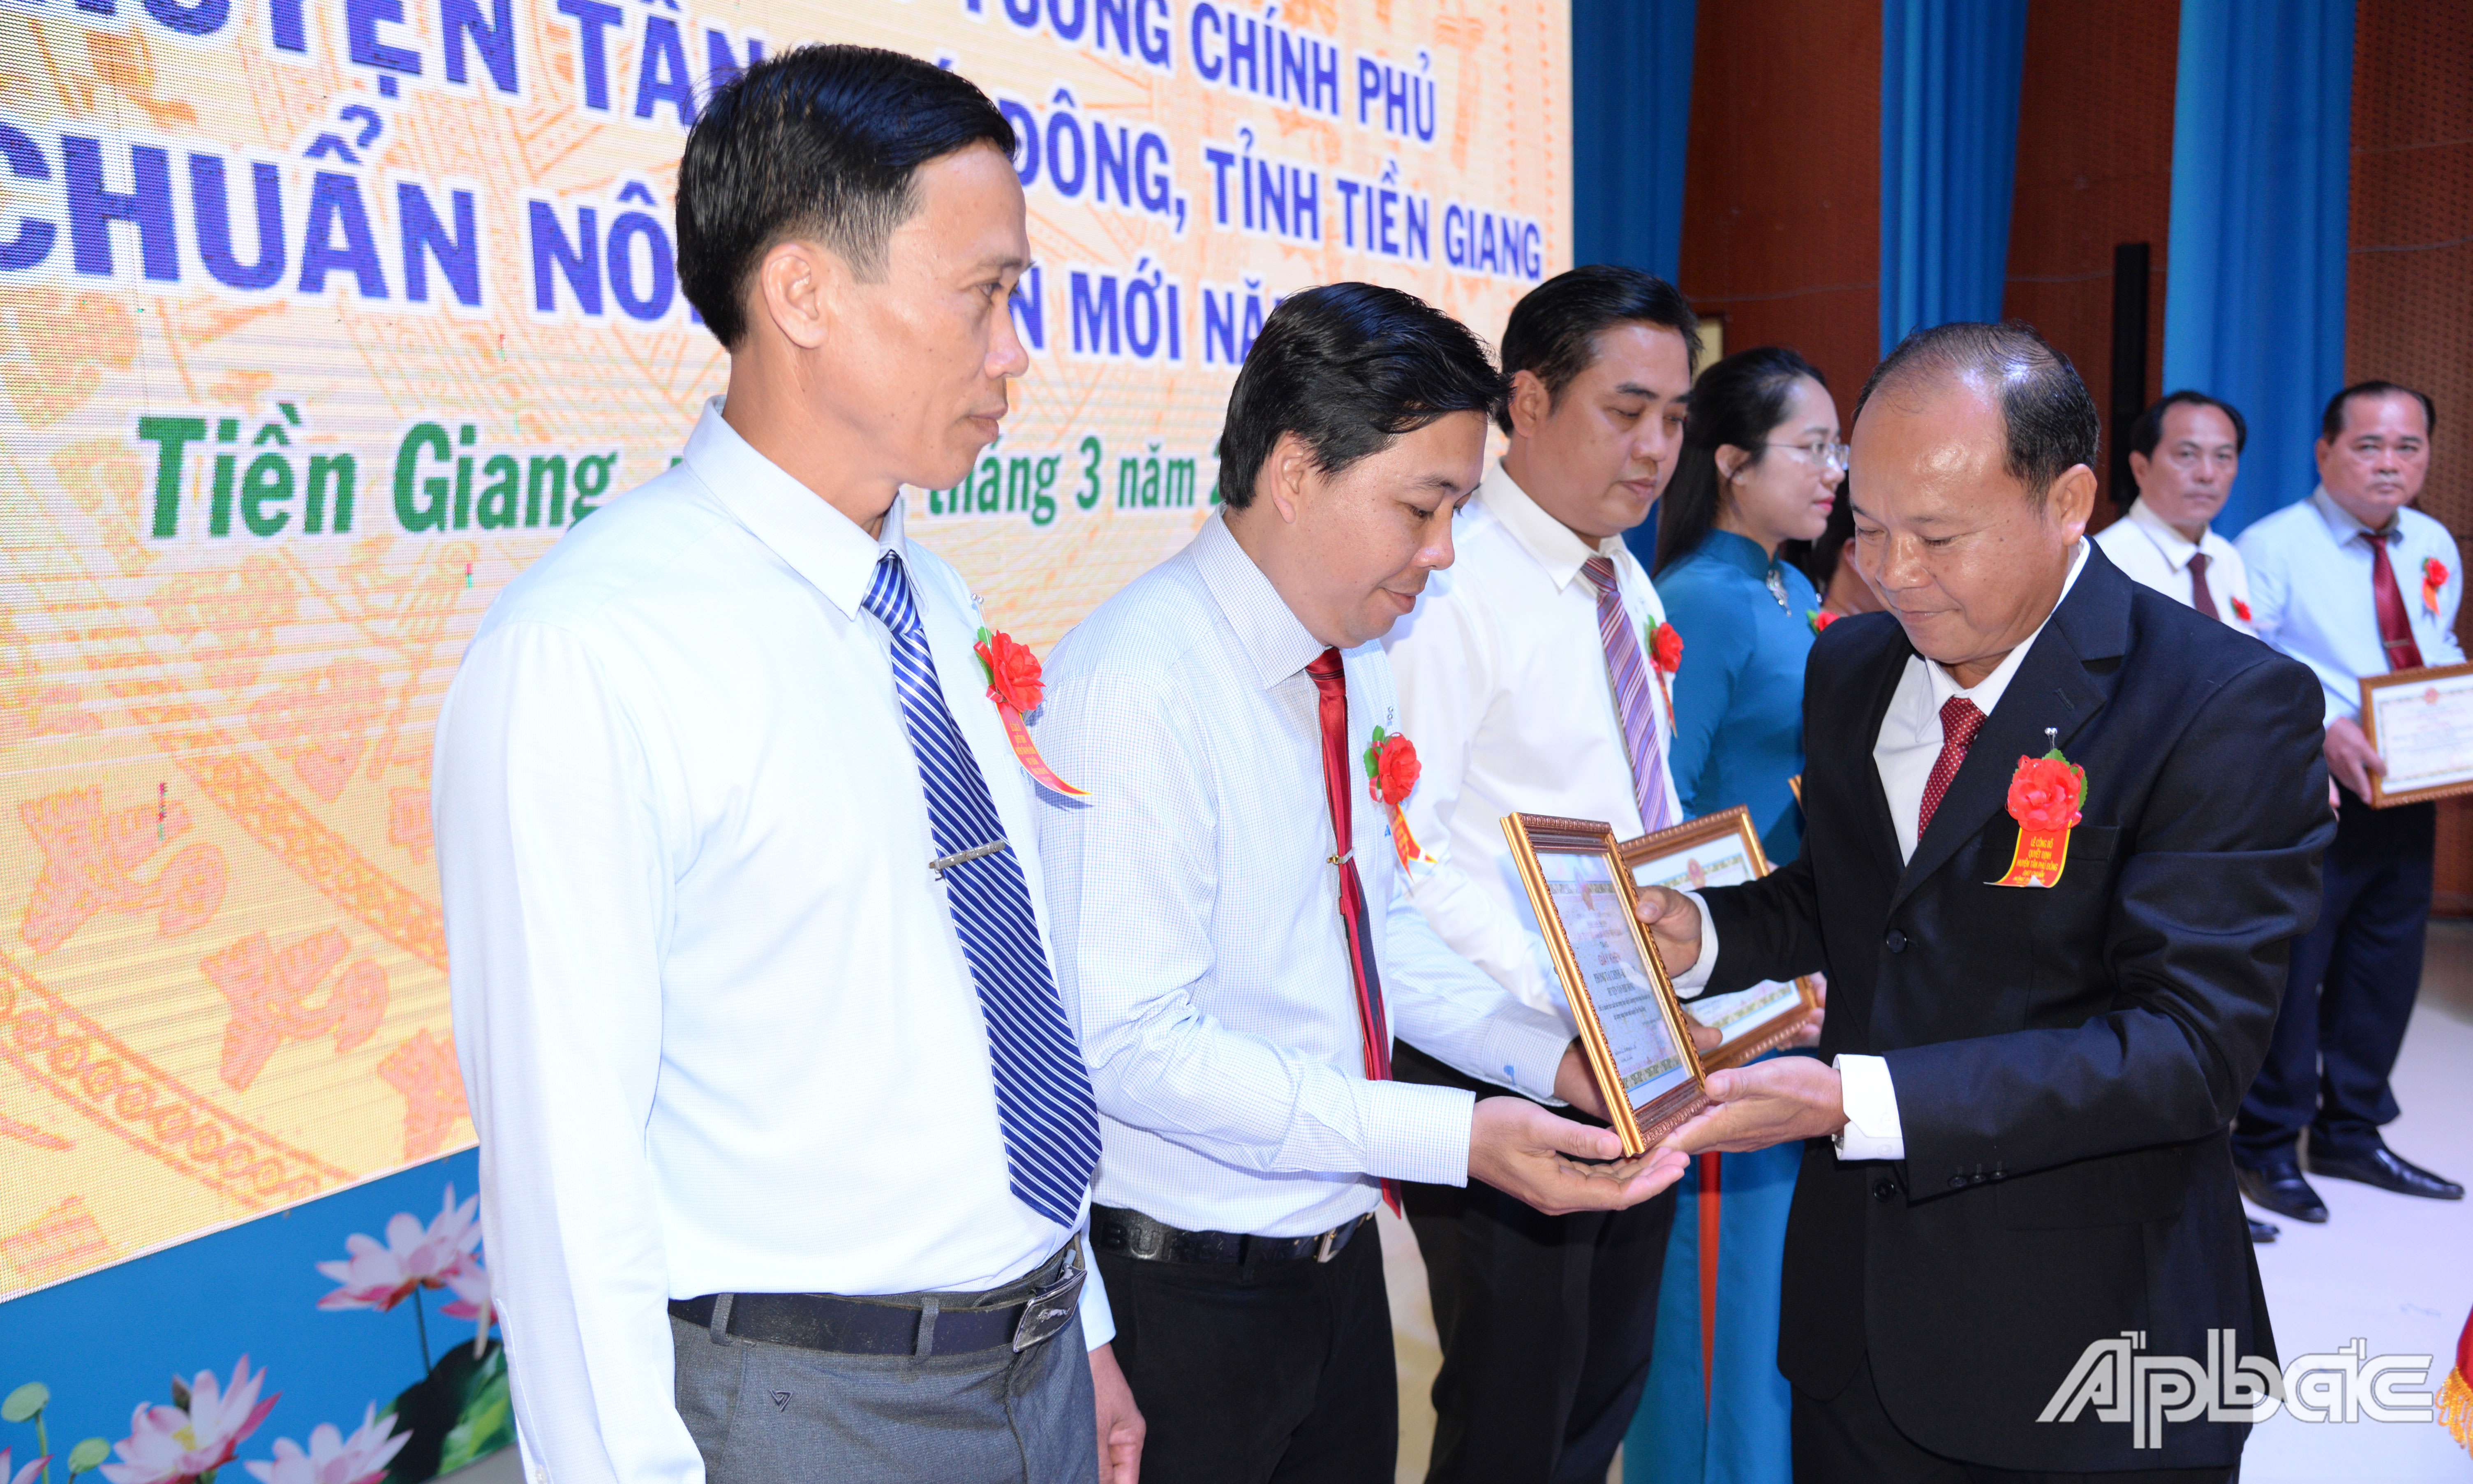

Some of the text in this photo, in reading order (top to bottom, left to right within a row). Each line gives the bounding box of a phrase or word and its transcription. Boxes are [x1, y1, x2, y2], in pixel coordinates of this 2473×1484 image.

[1192, 2, 1339, 116] CHÍNH
[1357, 52, 1434, 142] PHỦ
[0, 104, 483, 306] CHUẨN
[1205, 127, 1319, 241] TỈNH
[1336, 160, 1429, 261] TIỀN
[1444, 204, 1541, 280] GIANG
[1070, 257, 1181, 361] MỚI
[1203, 277, 1287, 364] NĂ
[137, 400, 357, 538] Tiền
[1077, 435, 1102, 510] 3
[1119, 444, 1195, 508] năm
